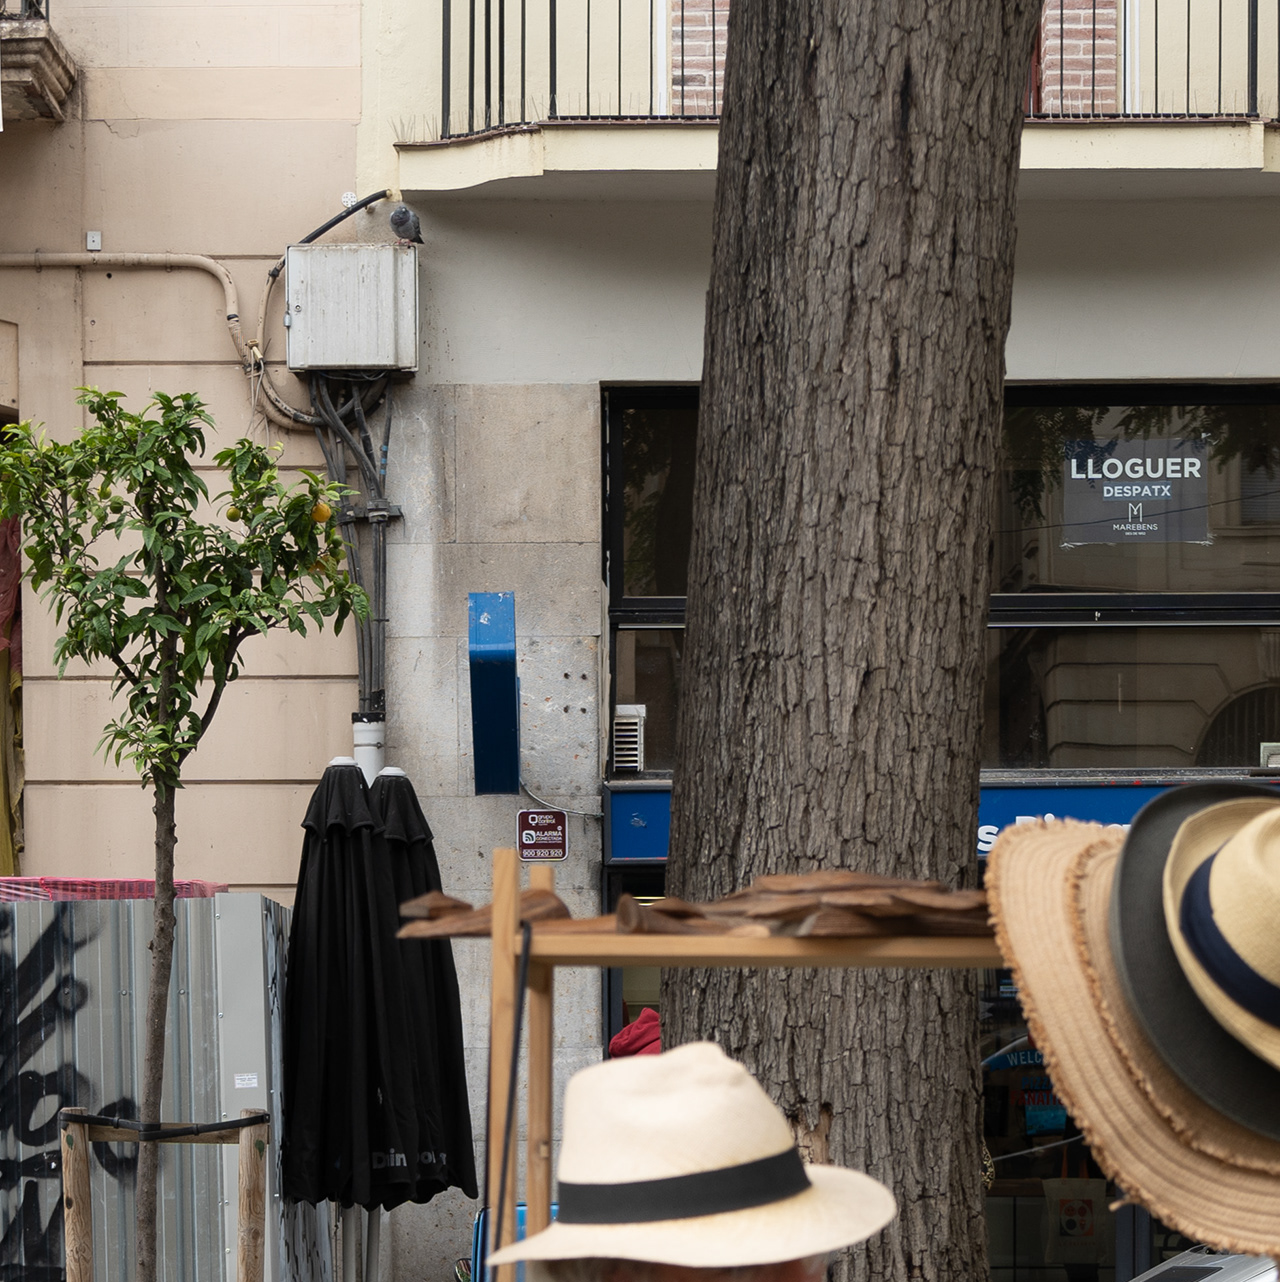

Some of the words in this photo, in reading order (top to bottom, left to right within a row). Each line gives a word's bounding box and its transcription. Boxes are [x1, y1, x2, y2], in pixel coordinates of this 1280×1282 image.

[1071, 457, 1202, 479] LLOGUER
[1103, 485, 1172, 498] DESPATX
[1112, 523, 1159, 531] MAREBENS
